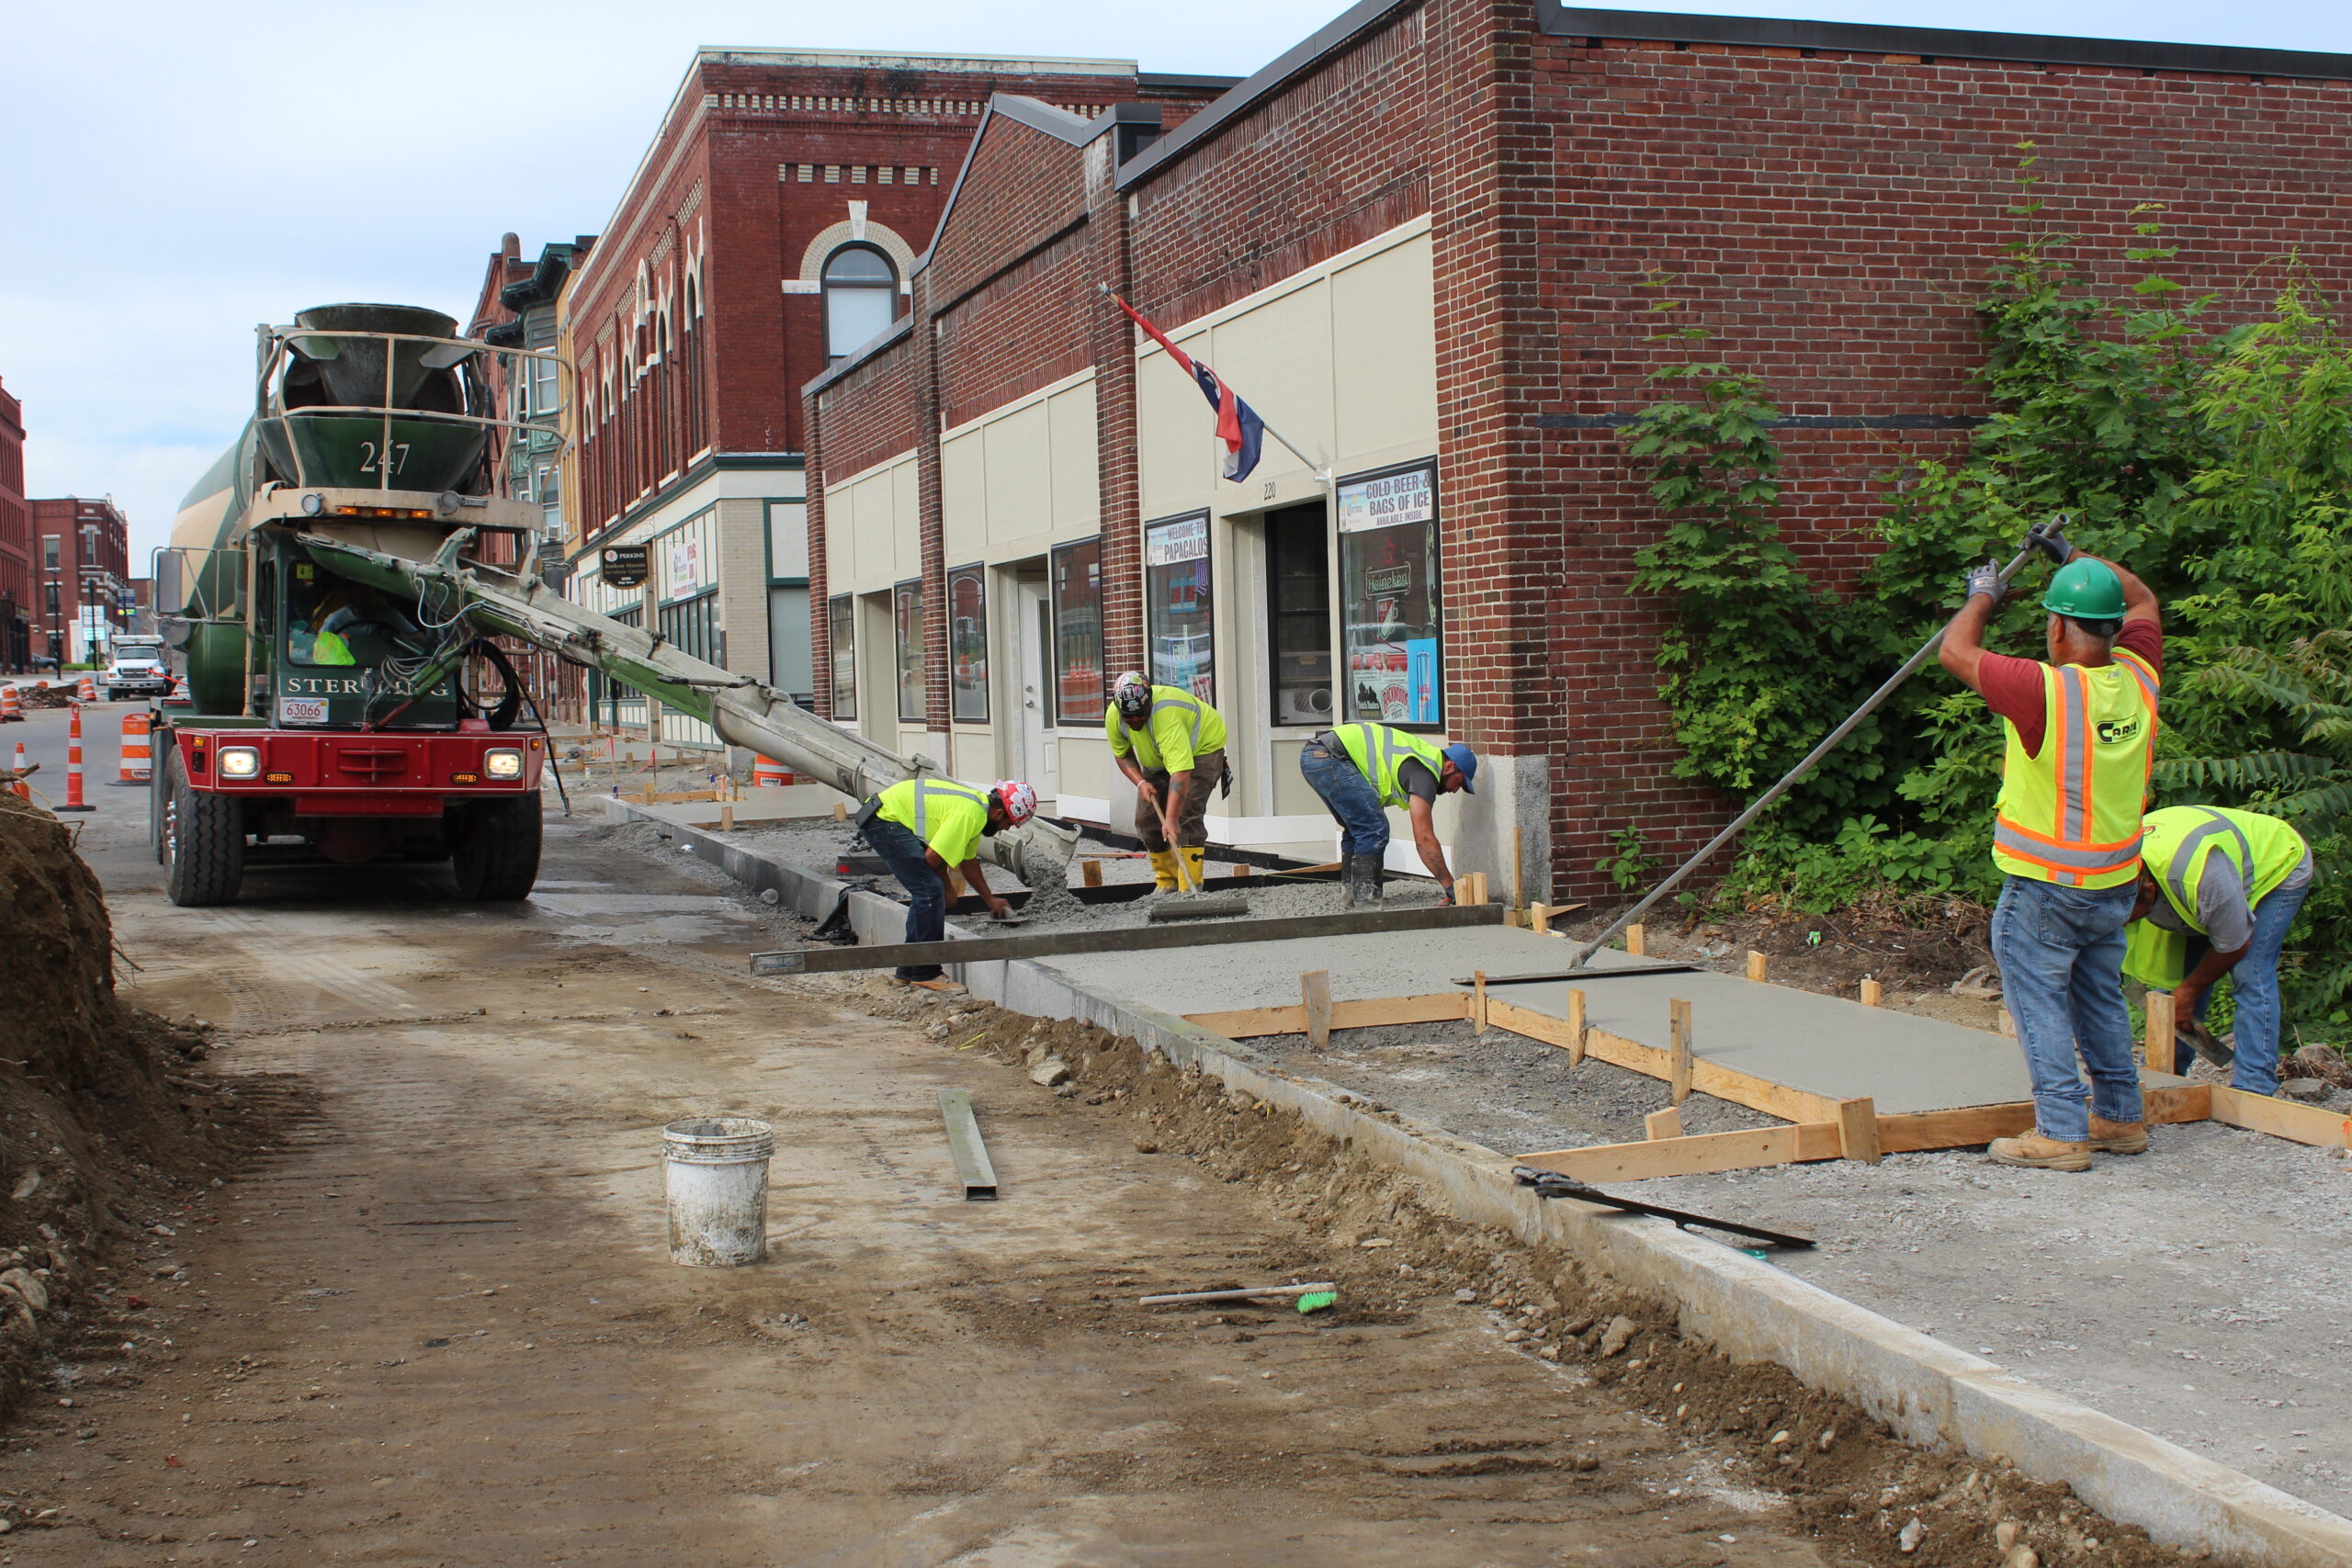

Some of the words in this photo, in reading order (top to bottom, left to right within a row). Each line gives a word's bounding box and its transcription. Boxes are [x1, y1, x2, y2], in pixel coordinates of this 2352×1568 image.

[359, 439, 411, 475] 247
[1264, 481, 1276, 501] 220
[1366, 480, 1391, 500] COLD
[1394, 475, 1419, 494] BEER
[1422, 471, 1432, 489] &
[1369, 497, 1396, 516] BAGS
[1398, 494, 1411, 512] OF
[1413, 491, 1430, 508] ICE
[1376, 514, 1404, 526] AVAILABLE
[1405, 510, 1423, 522] INSIDE
[1167, 523, 1194, 540] WELCOME
[1196, 521, 1204, 535] TO
[1368, 570, 1408, 592] Heineken
[287, 704, 321, 716] 63066
